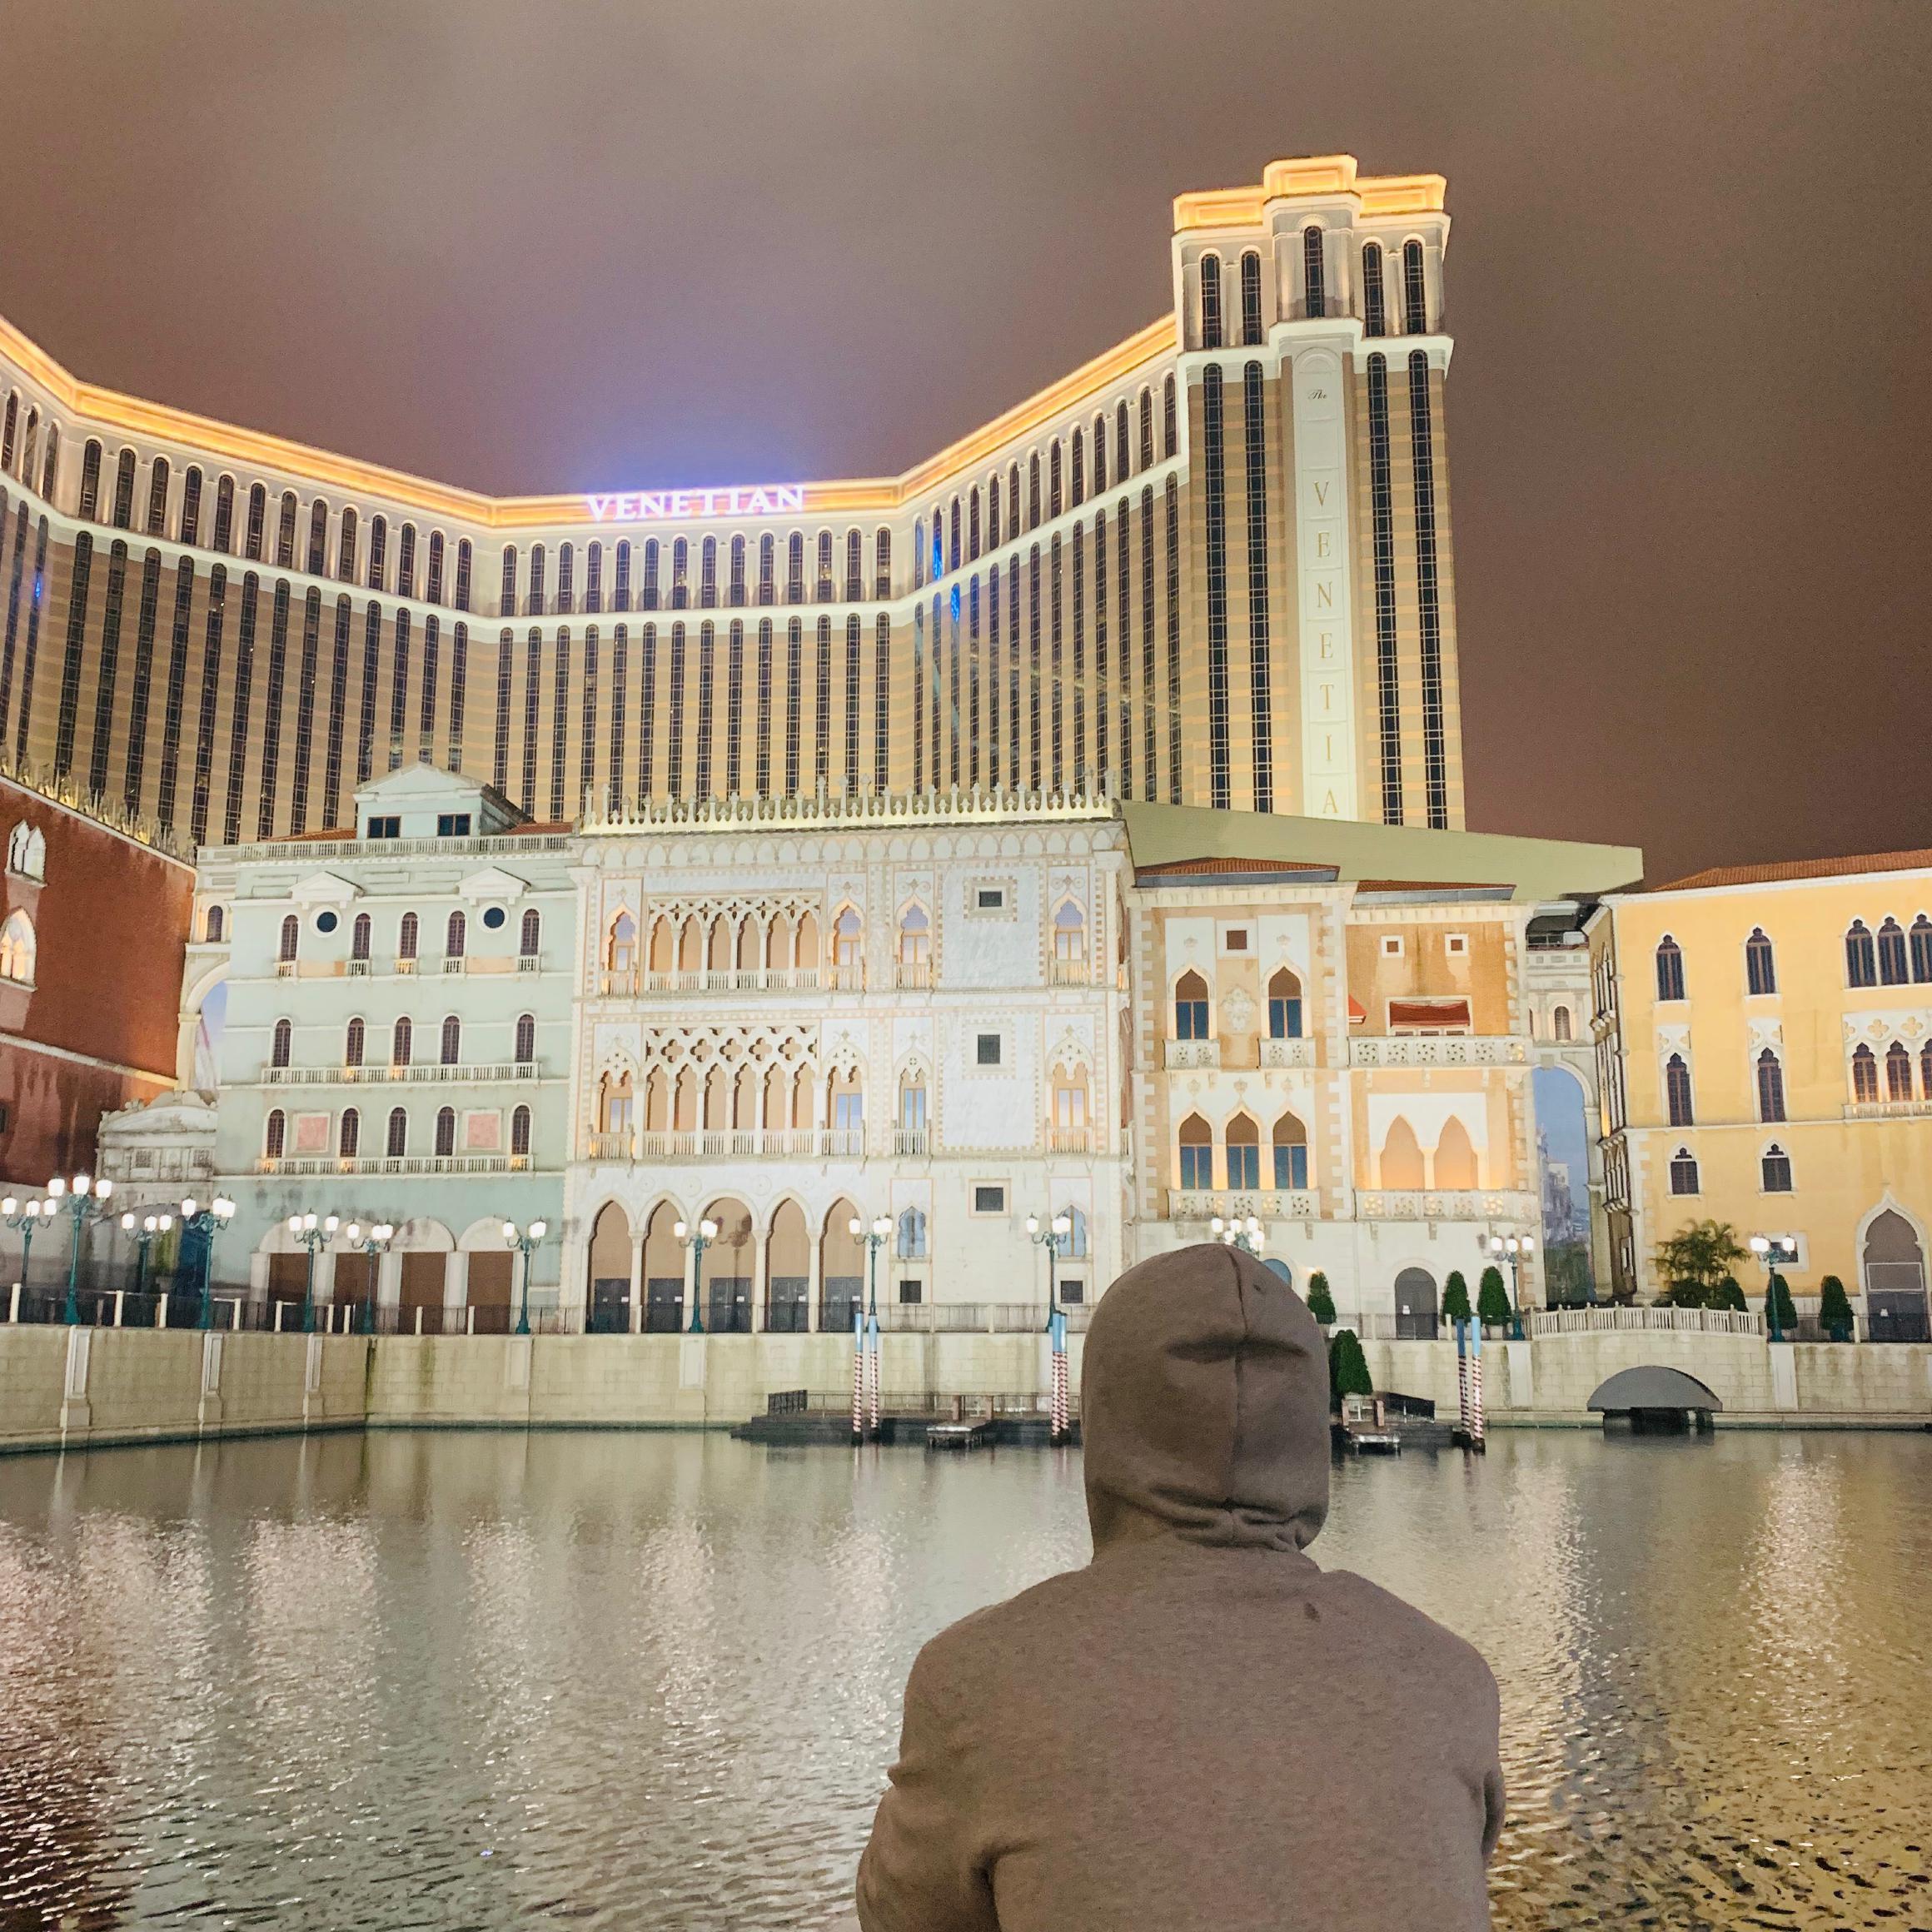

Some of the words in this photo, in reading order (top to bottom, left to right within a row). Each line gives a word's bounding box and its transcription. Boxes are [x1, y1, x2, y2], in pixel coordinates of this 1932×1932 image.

[1307, 389, 1328, 400] The
[585, 485, 804, 522] VENETIAN
[1312, 480, 1338, 814] VENETIA
